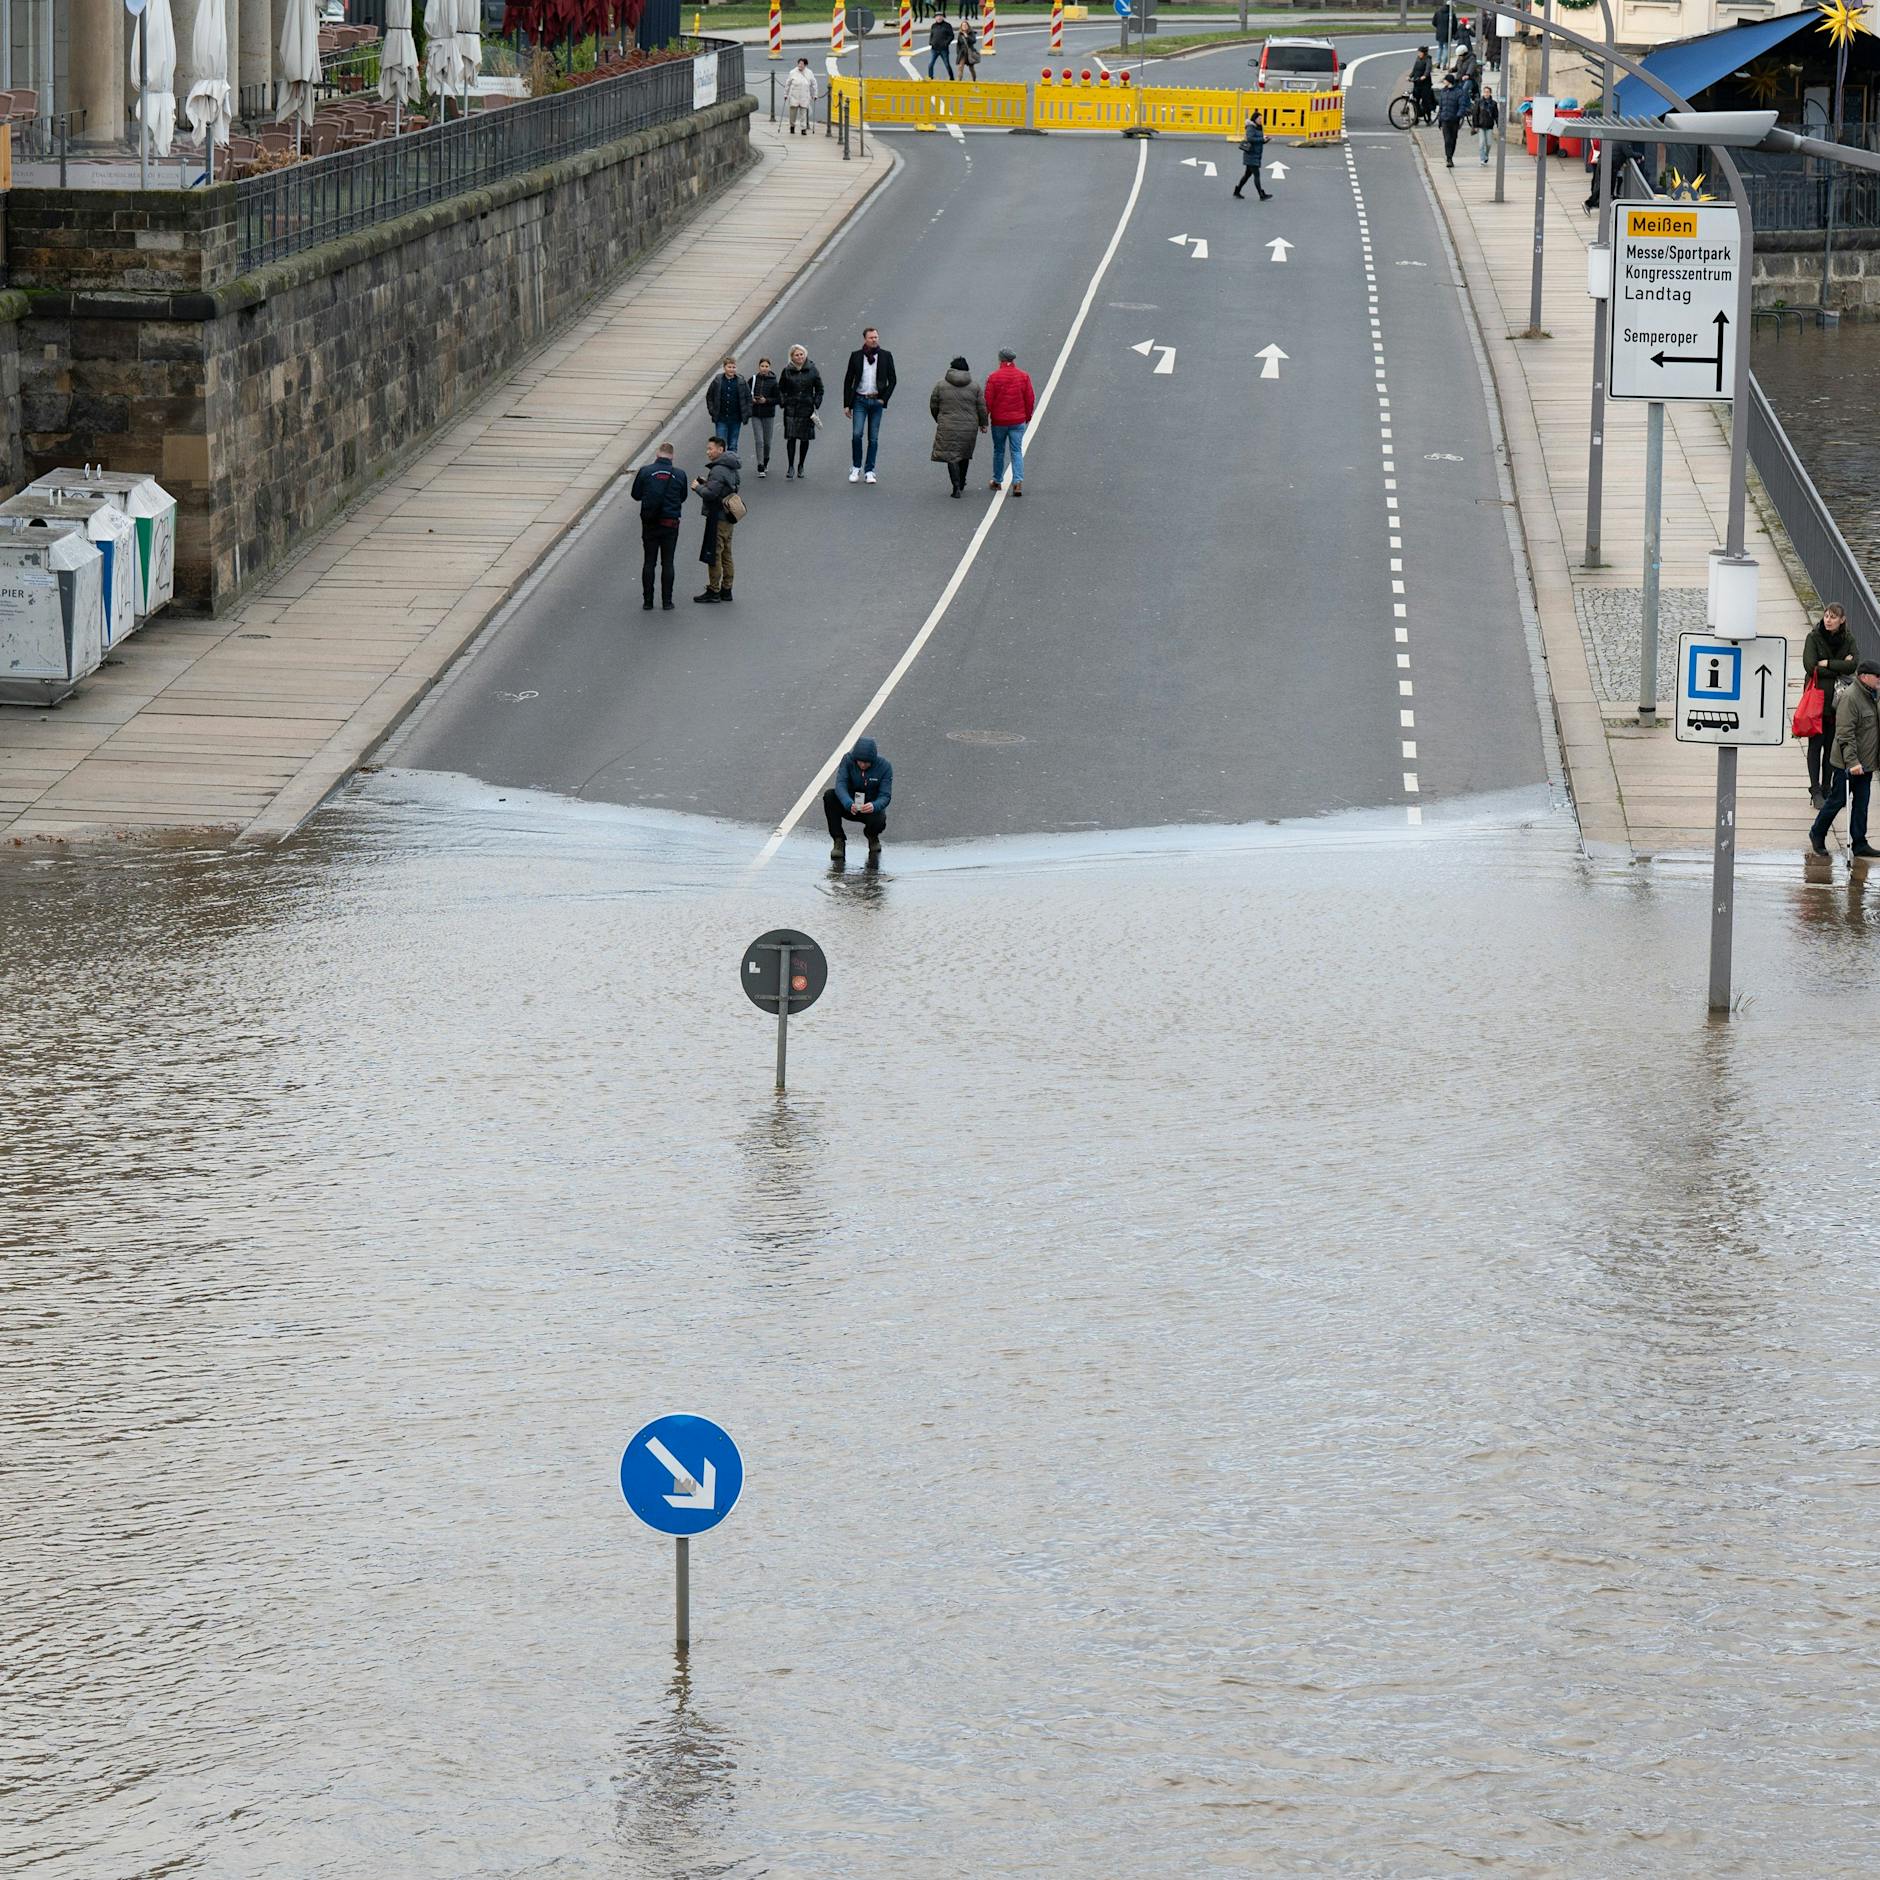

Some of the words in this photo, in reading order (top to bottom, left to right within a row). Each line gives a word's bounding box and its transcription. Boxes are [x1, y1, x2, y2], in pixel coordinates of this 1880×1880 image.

[1633, 217, 1692, 233] Meißen
[1626, 244, 1732, 264] Messe/Sportpark
[1625, 264, 1732, 283] Kongresszentrum
[1625, 285, 1691, 305] Landtag
[1623, 328, 1699, 347] Semperoper
[0, 588, 24, 598] PIER
